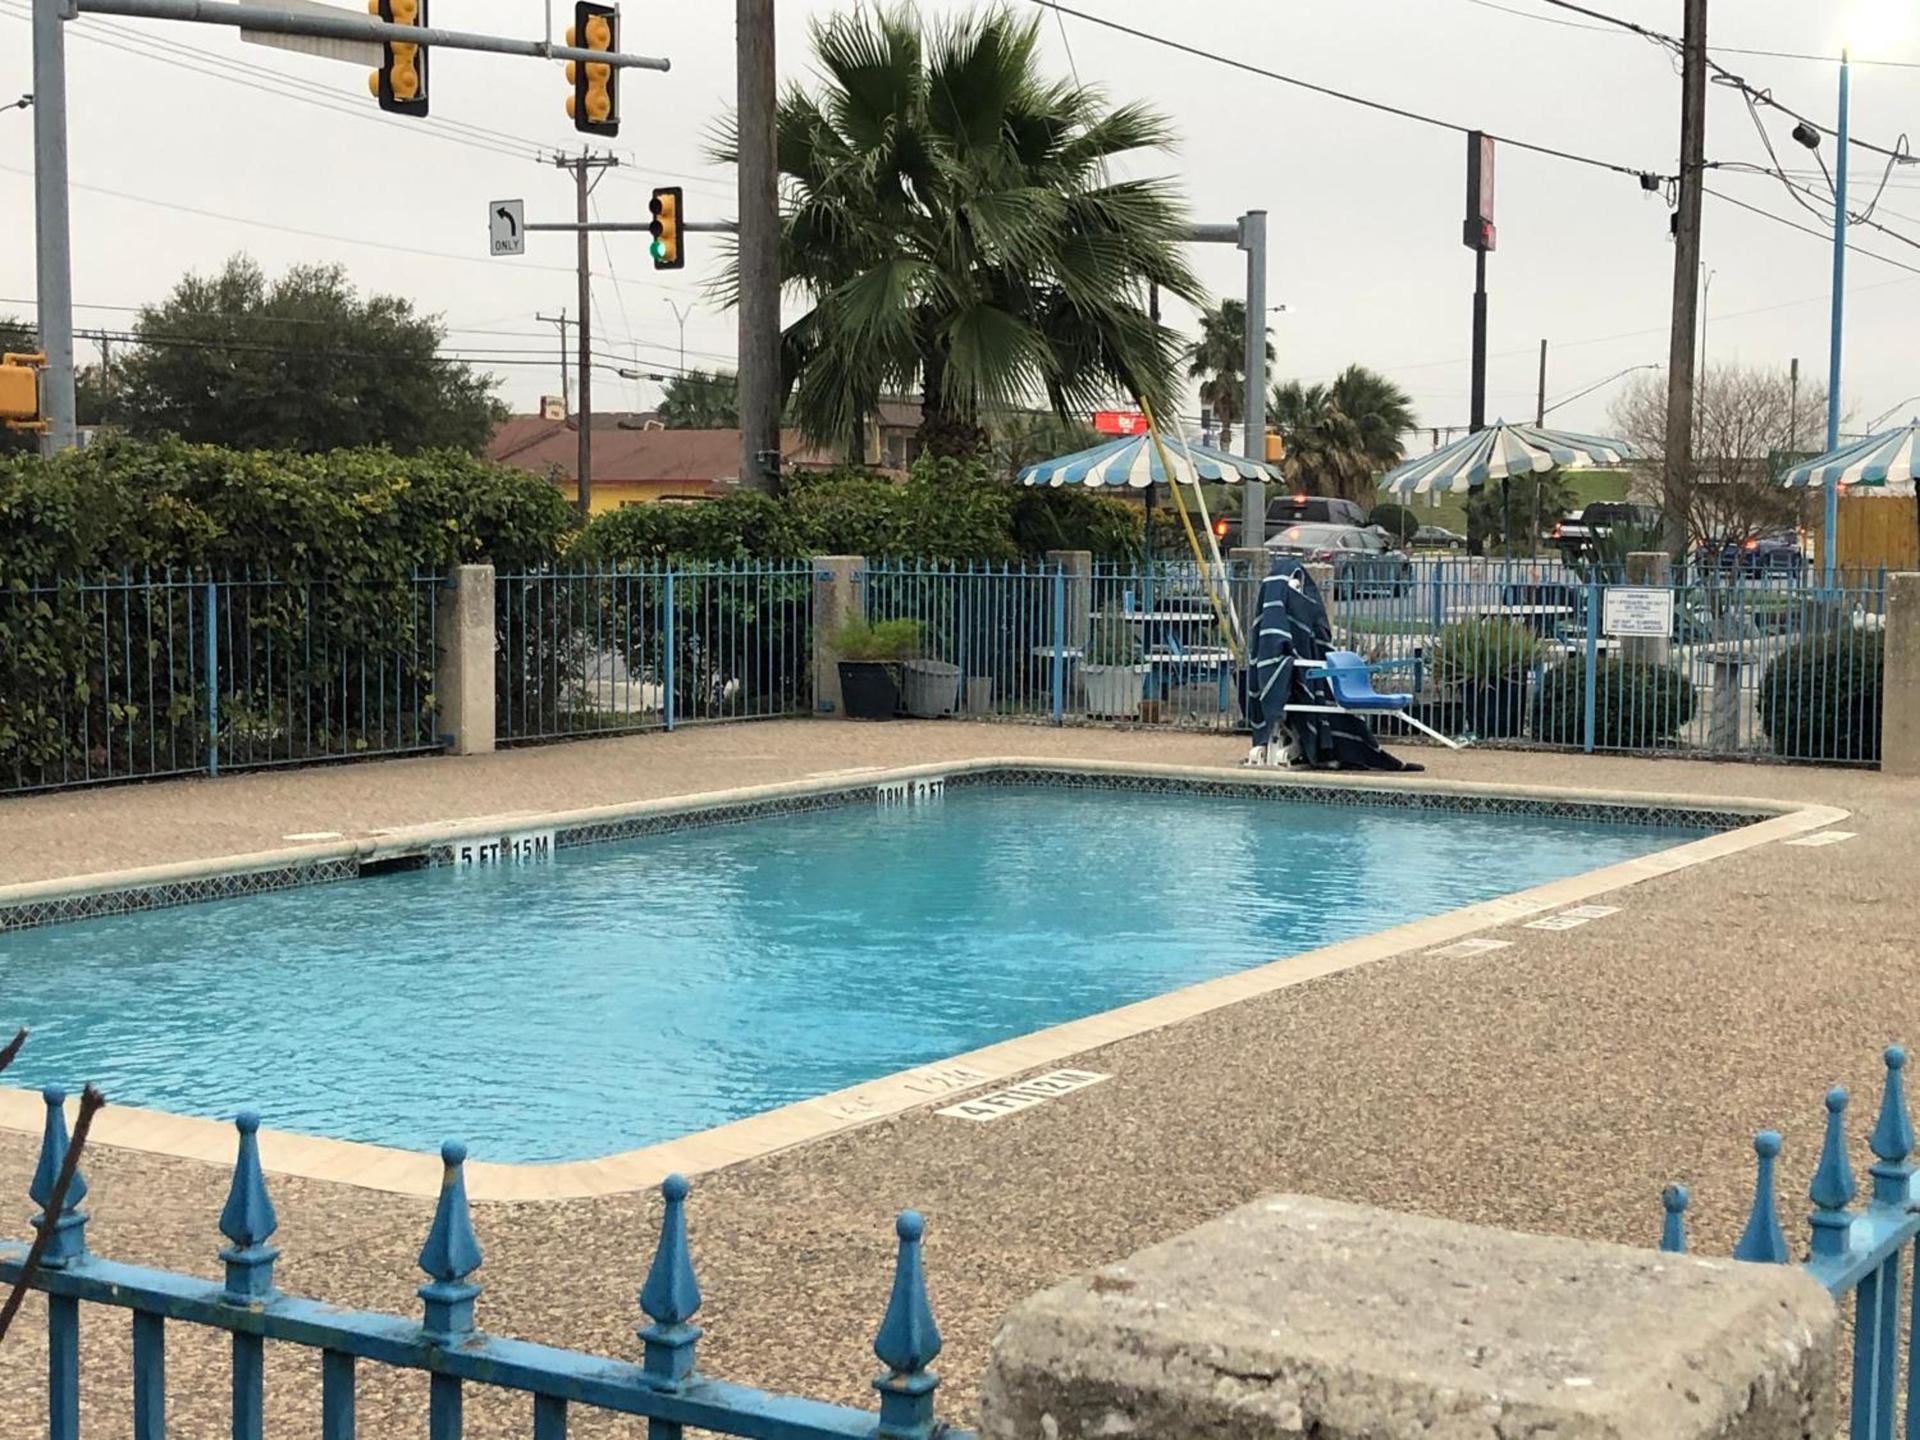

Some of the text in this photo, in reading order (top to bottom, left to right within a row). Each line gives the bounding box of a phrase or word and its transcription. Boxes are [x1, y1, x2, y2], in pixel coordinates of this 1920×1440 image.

[495, 239, 520, 251] ONLY
[461, 846, 472, 864] 5
[480, 843, 499, 862] FT
[959, 1105, 997, 1116] 4
[979, 1093, 1033, 1108] FT
